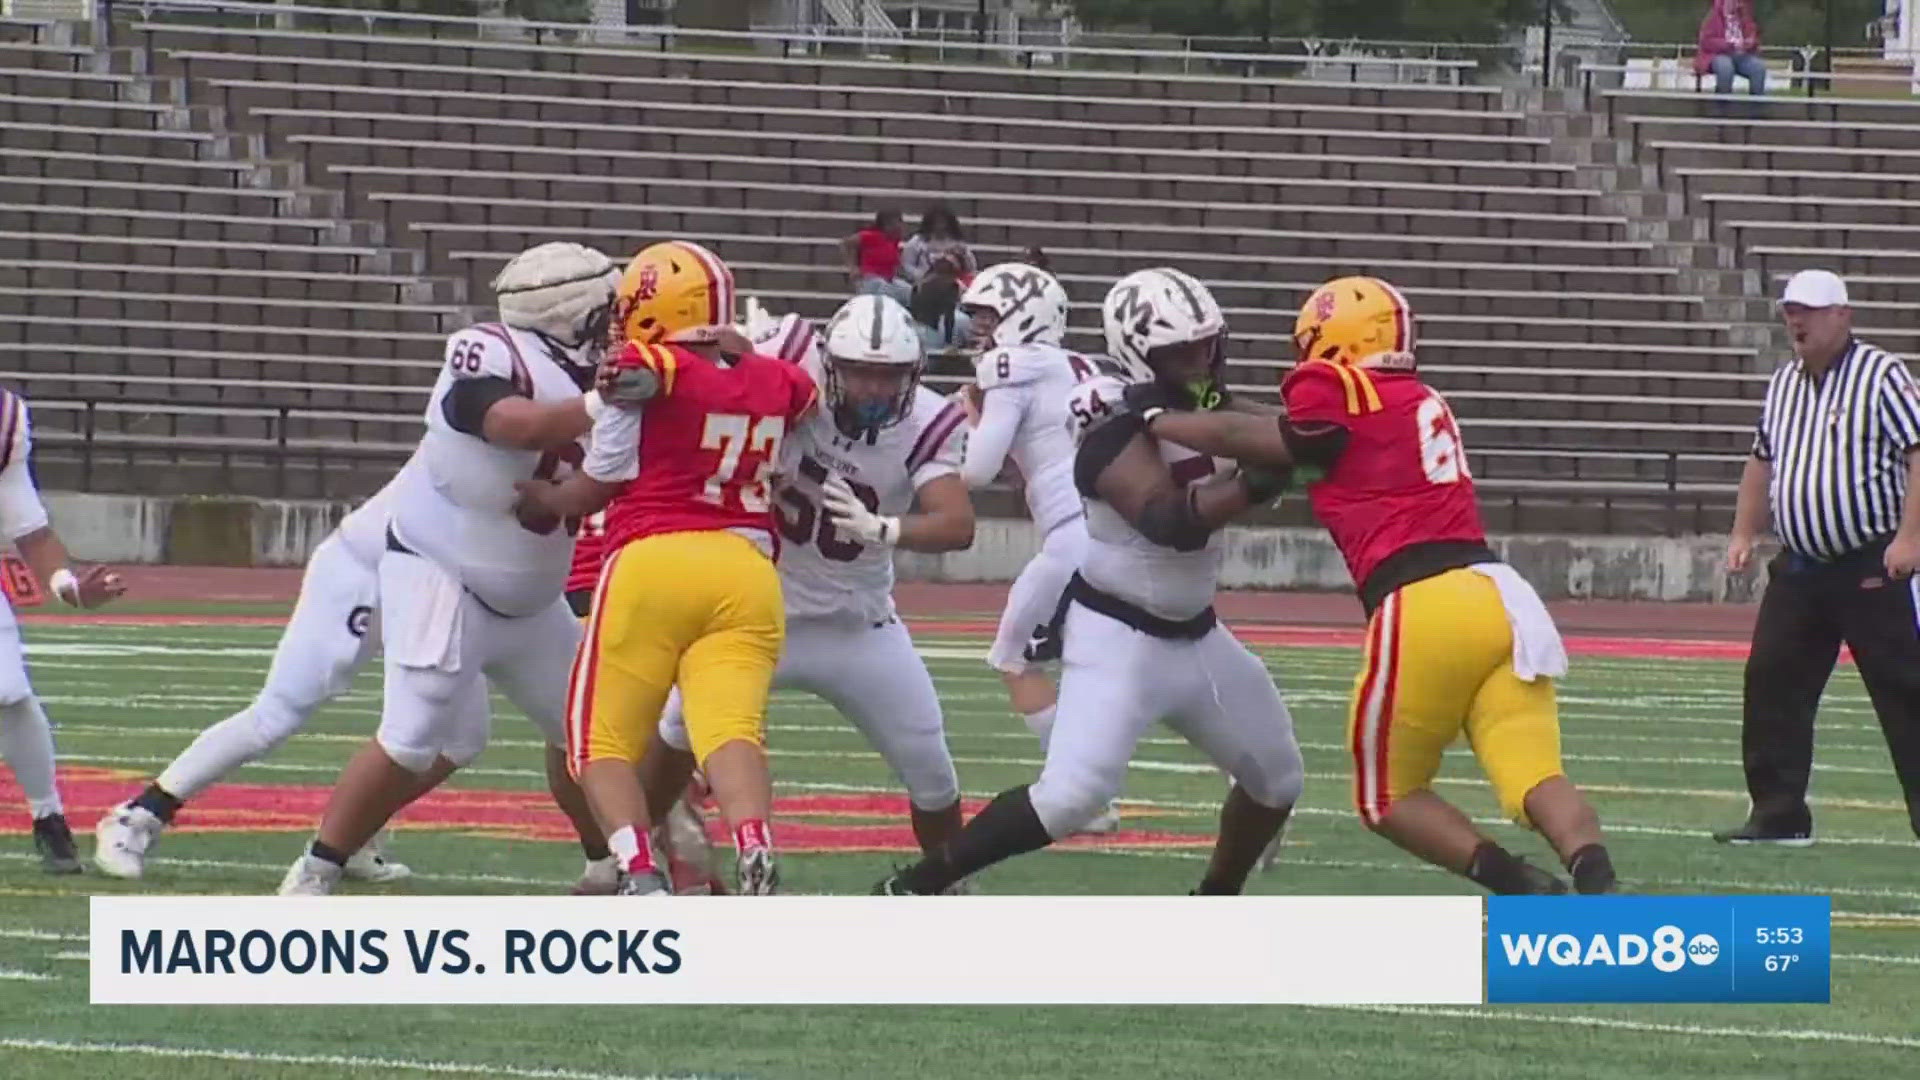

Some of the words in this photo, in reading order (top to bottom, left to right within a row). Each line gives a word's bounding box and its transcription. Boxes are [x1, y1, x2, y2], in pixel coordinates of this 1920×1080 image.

[451, 339, 485, 373] 66
[997, 352, 1010, 379] 8
[1069, 388, 1112, 428] 54
[700, 412, 786, 513] 73
